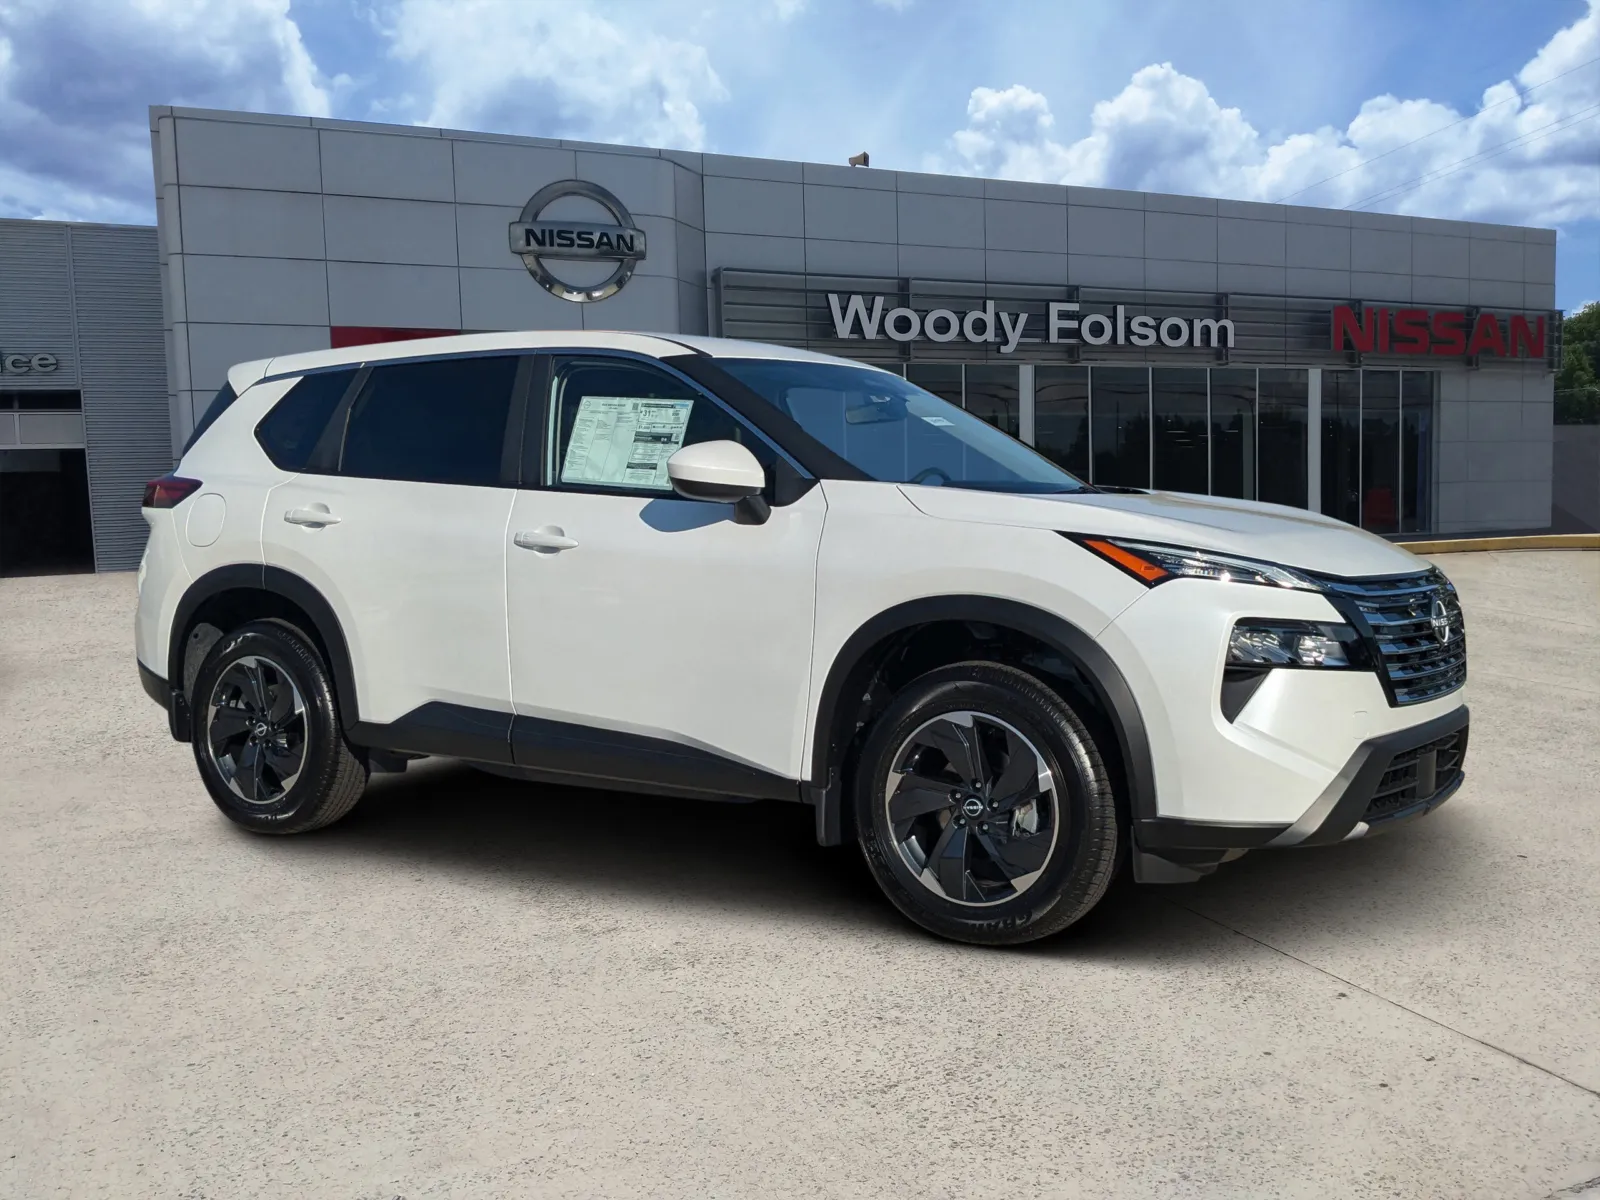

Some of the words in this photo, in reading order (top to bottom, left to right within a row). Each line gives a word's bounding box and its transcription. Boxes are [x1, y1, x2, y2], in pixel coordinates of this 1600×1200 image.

[525, 228, 634, 252] NISSAN
[827, 293, 1028, 353] Woody
[1048, 301, 1236, 348] Folsom
[1331, 305, 1545, 358] NISSAN
[0, 353, 57, 374] ce
